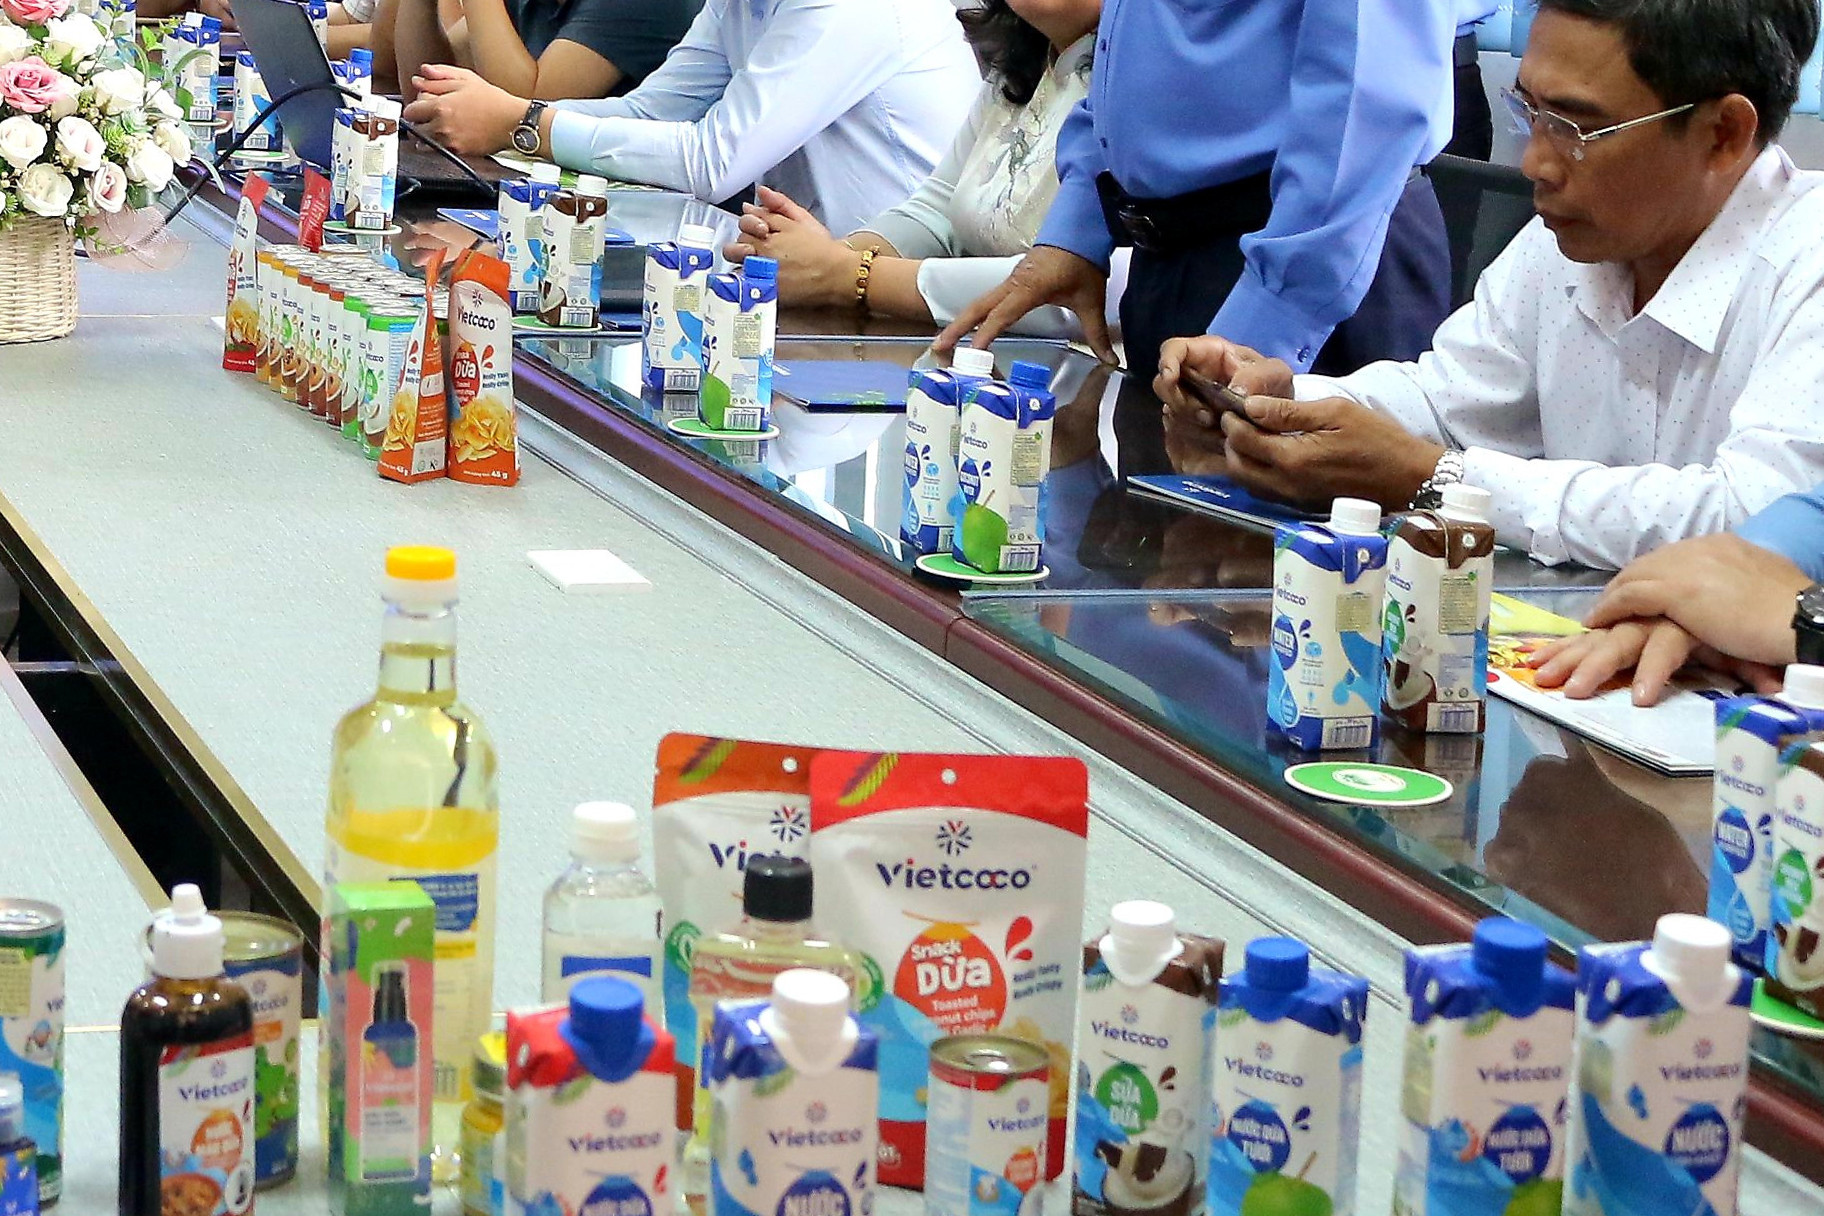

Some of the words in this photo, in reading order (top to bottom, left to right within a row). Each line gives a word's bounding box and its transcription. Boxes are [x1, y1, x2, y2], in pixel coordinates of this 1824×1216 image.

[876, 858, 1031, 889] Vietcoco
[911, 940, 962, 961] Snack
[932, 995, 979, 1011] Toasted
[1092, 1020, 1169, 1049] Vietcoco
[1224, 1056, 1304, 1088] Vietcoco
[1478, 1063, 1563, 1082] Vietcoco
[1659, 1064, 1740, 1081] Vietcoco
[568, 1132, 662, 1153] Vietcoco
[768, 1128, 864, 1148] Vietcoco
